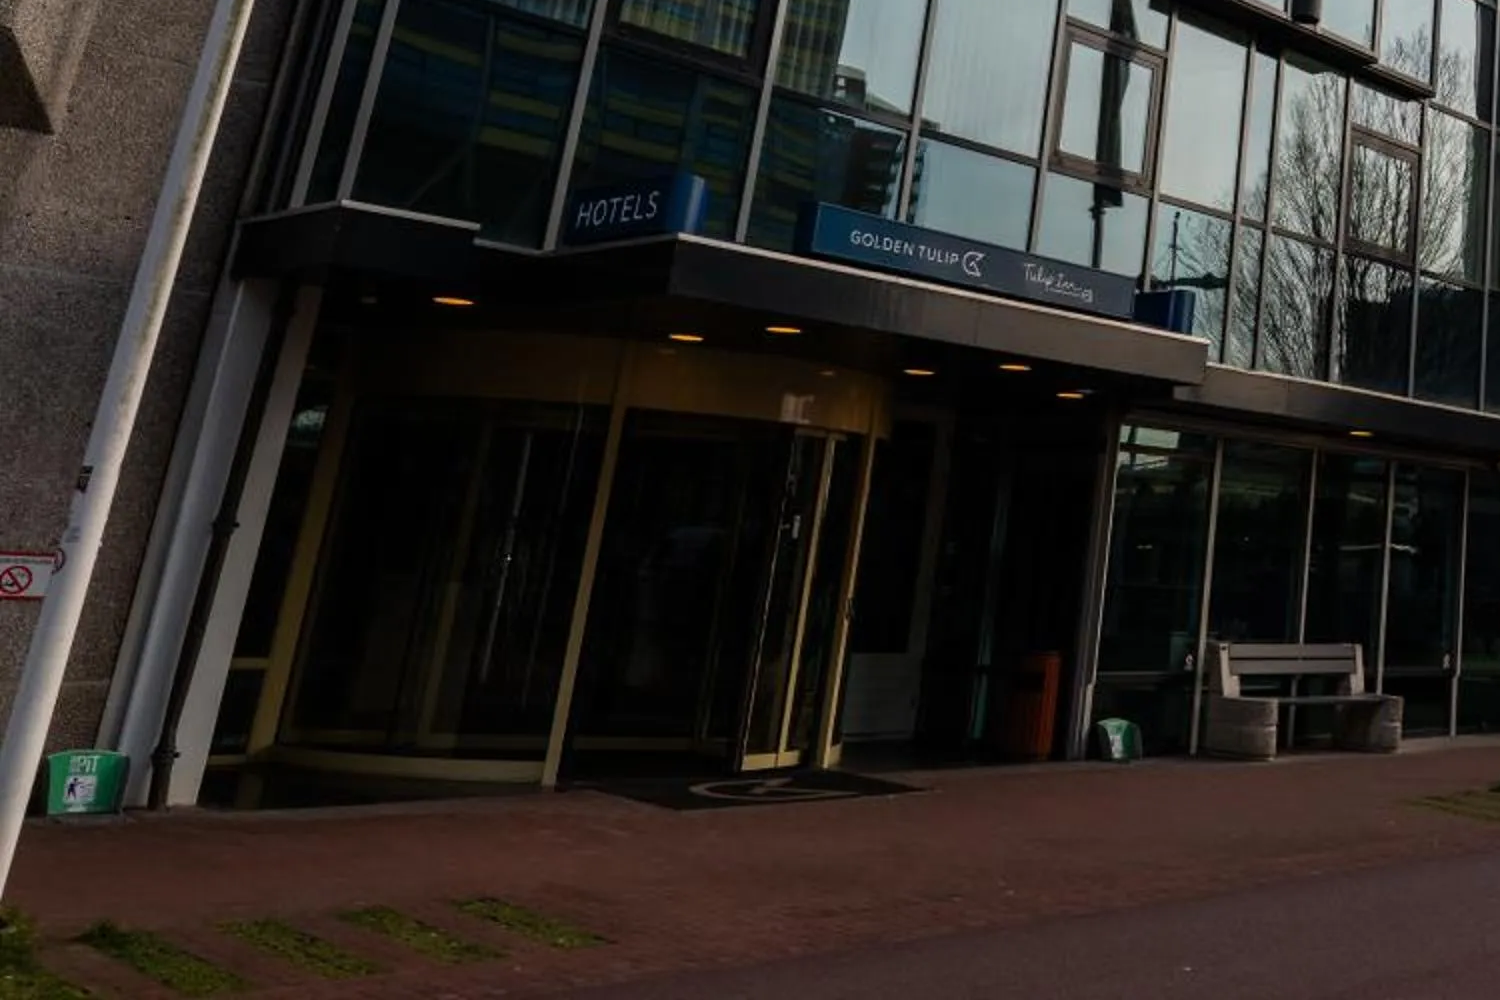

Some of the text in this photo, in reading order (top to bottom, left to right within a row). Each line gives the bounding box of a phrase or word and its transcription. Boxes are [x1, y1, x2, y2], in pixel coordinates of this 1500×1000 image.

[575, 190, 660, 229] HOTELS
[850, 229, 959, 265] GOLDEN TULIP
